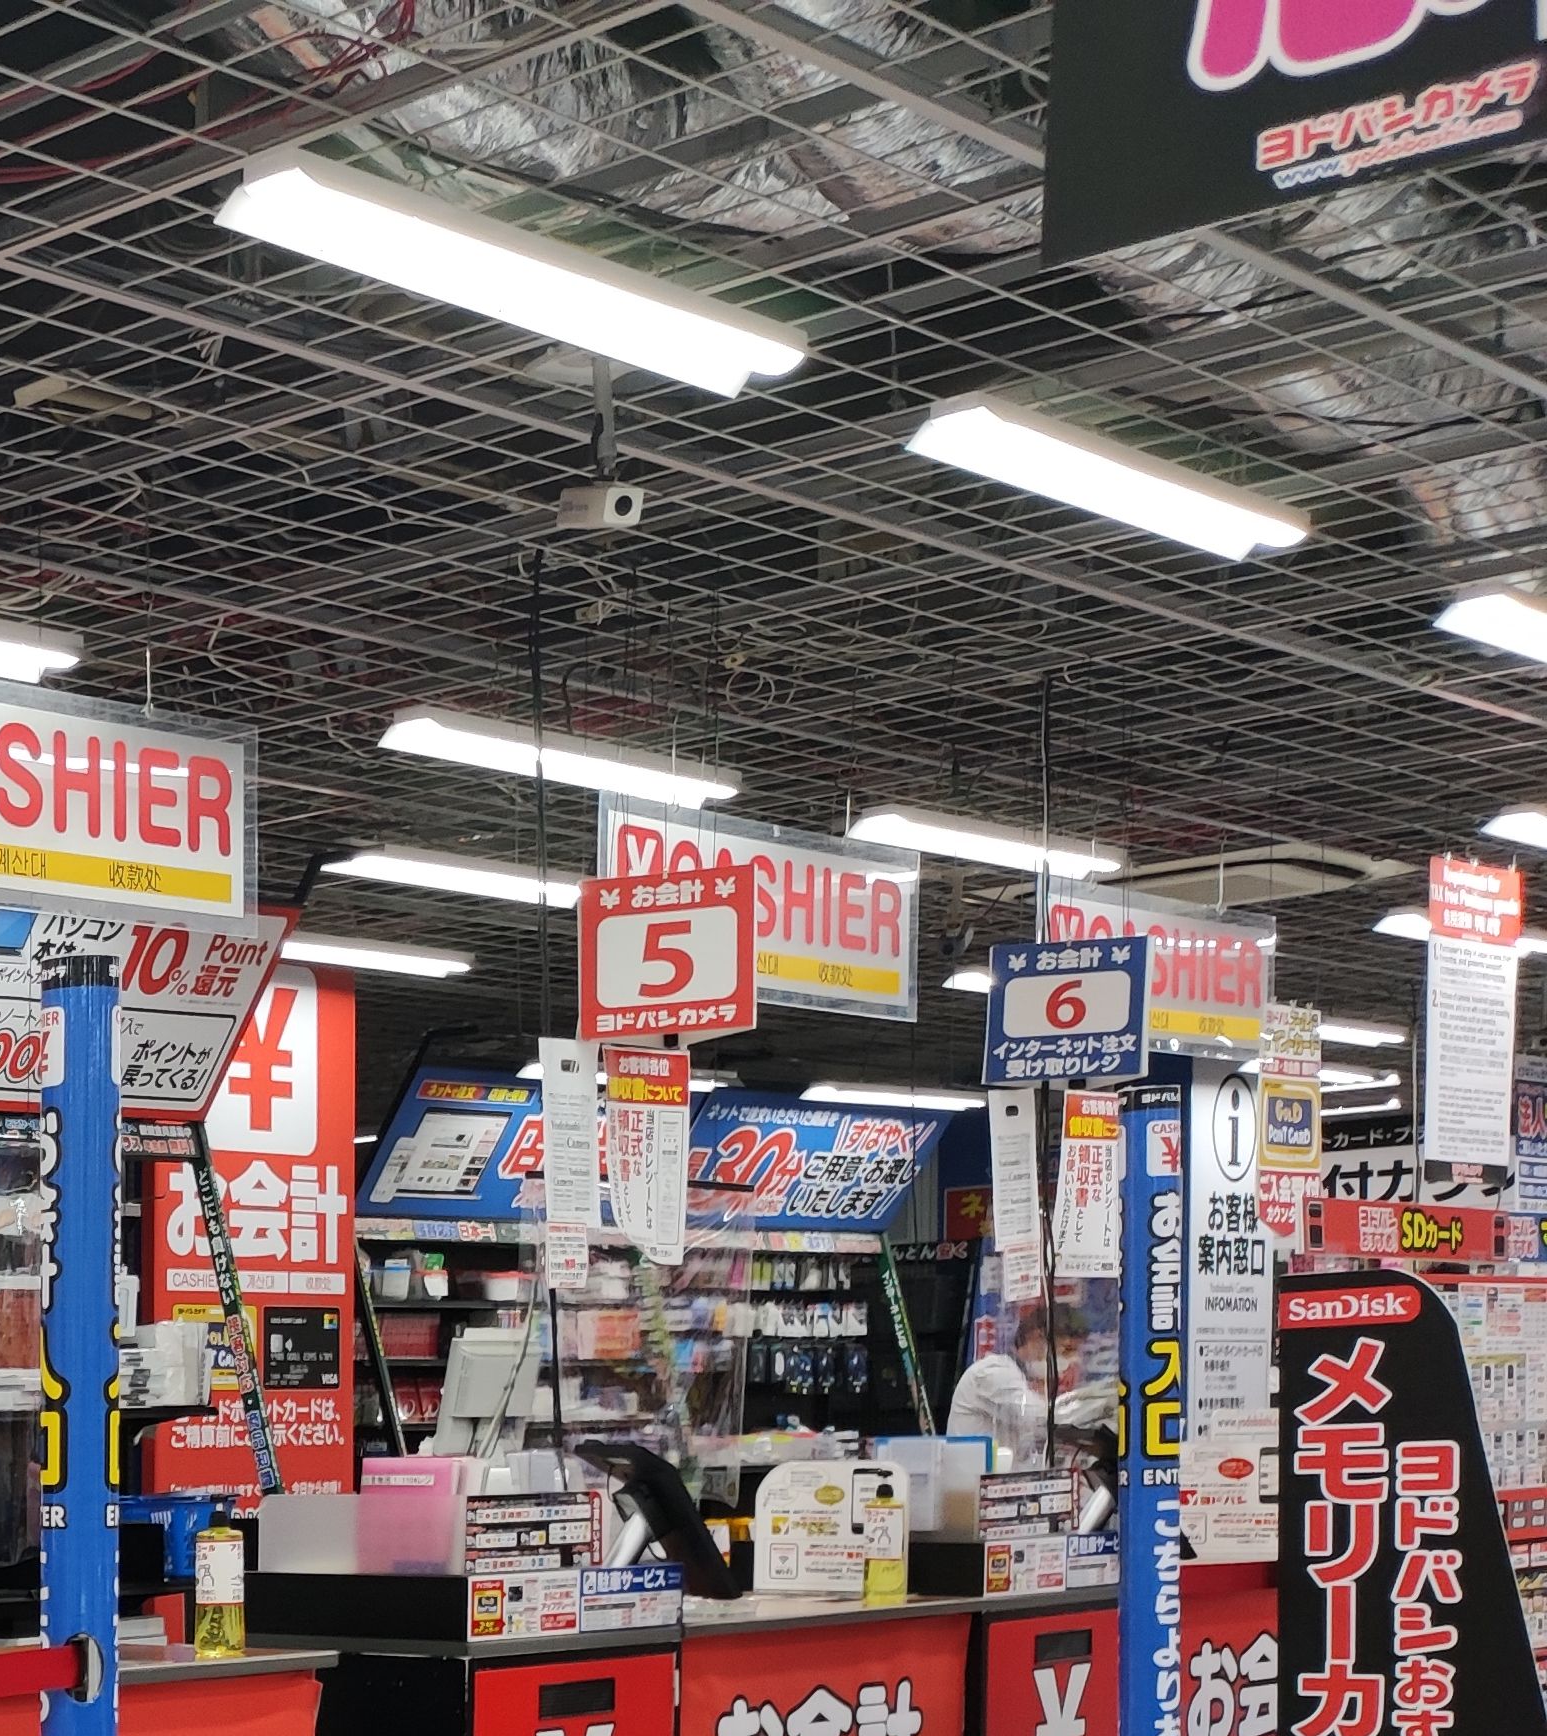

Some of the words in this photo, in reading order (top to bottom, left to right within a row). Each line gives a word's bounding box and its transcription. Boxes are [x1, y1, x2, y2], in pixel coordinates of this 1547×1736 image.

[1259, 60, 1539, 170] ヨドバシカメラ
[631, 880, 705, 907] お会計
[204, 933, 268, 967] Point
[637, 920, 694, 999] 5
[1035, 946, 1103, 971] お会計
[190, 964, 240, 997] 還元
[596, 1003, 738, 1034] ヨドバシカメラ
[1045, 979, 1087, 1030] 6
[132, 1038, 211, 1066] ポイントが
[992, 1033, 1137, 1059] インターネット注文
[122, 1064, 207, 1092] 戻ってくる!
[1005, 1053, 1122, 1079] 受け取りレジ
[1401, 1211, 1464, 1252] SDカード
[1197, 1235, 1265, 1277] 案内窓口
[171, 1271, 217, 1289] CASHIE
[1204, 1296, 1258, 1314] INFOMATION
[1287, 1289, 1413, 1322] SanDisk
